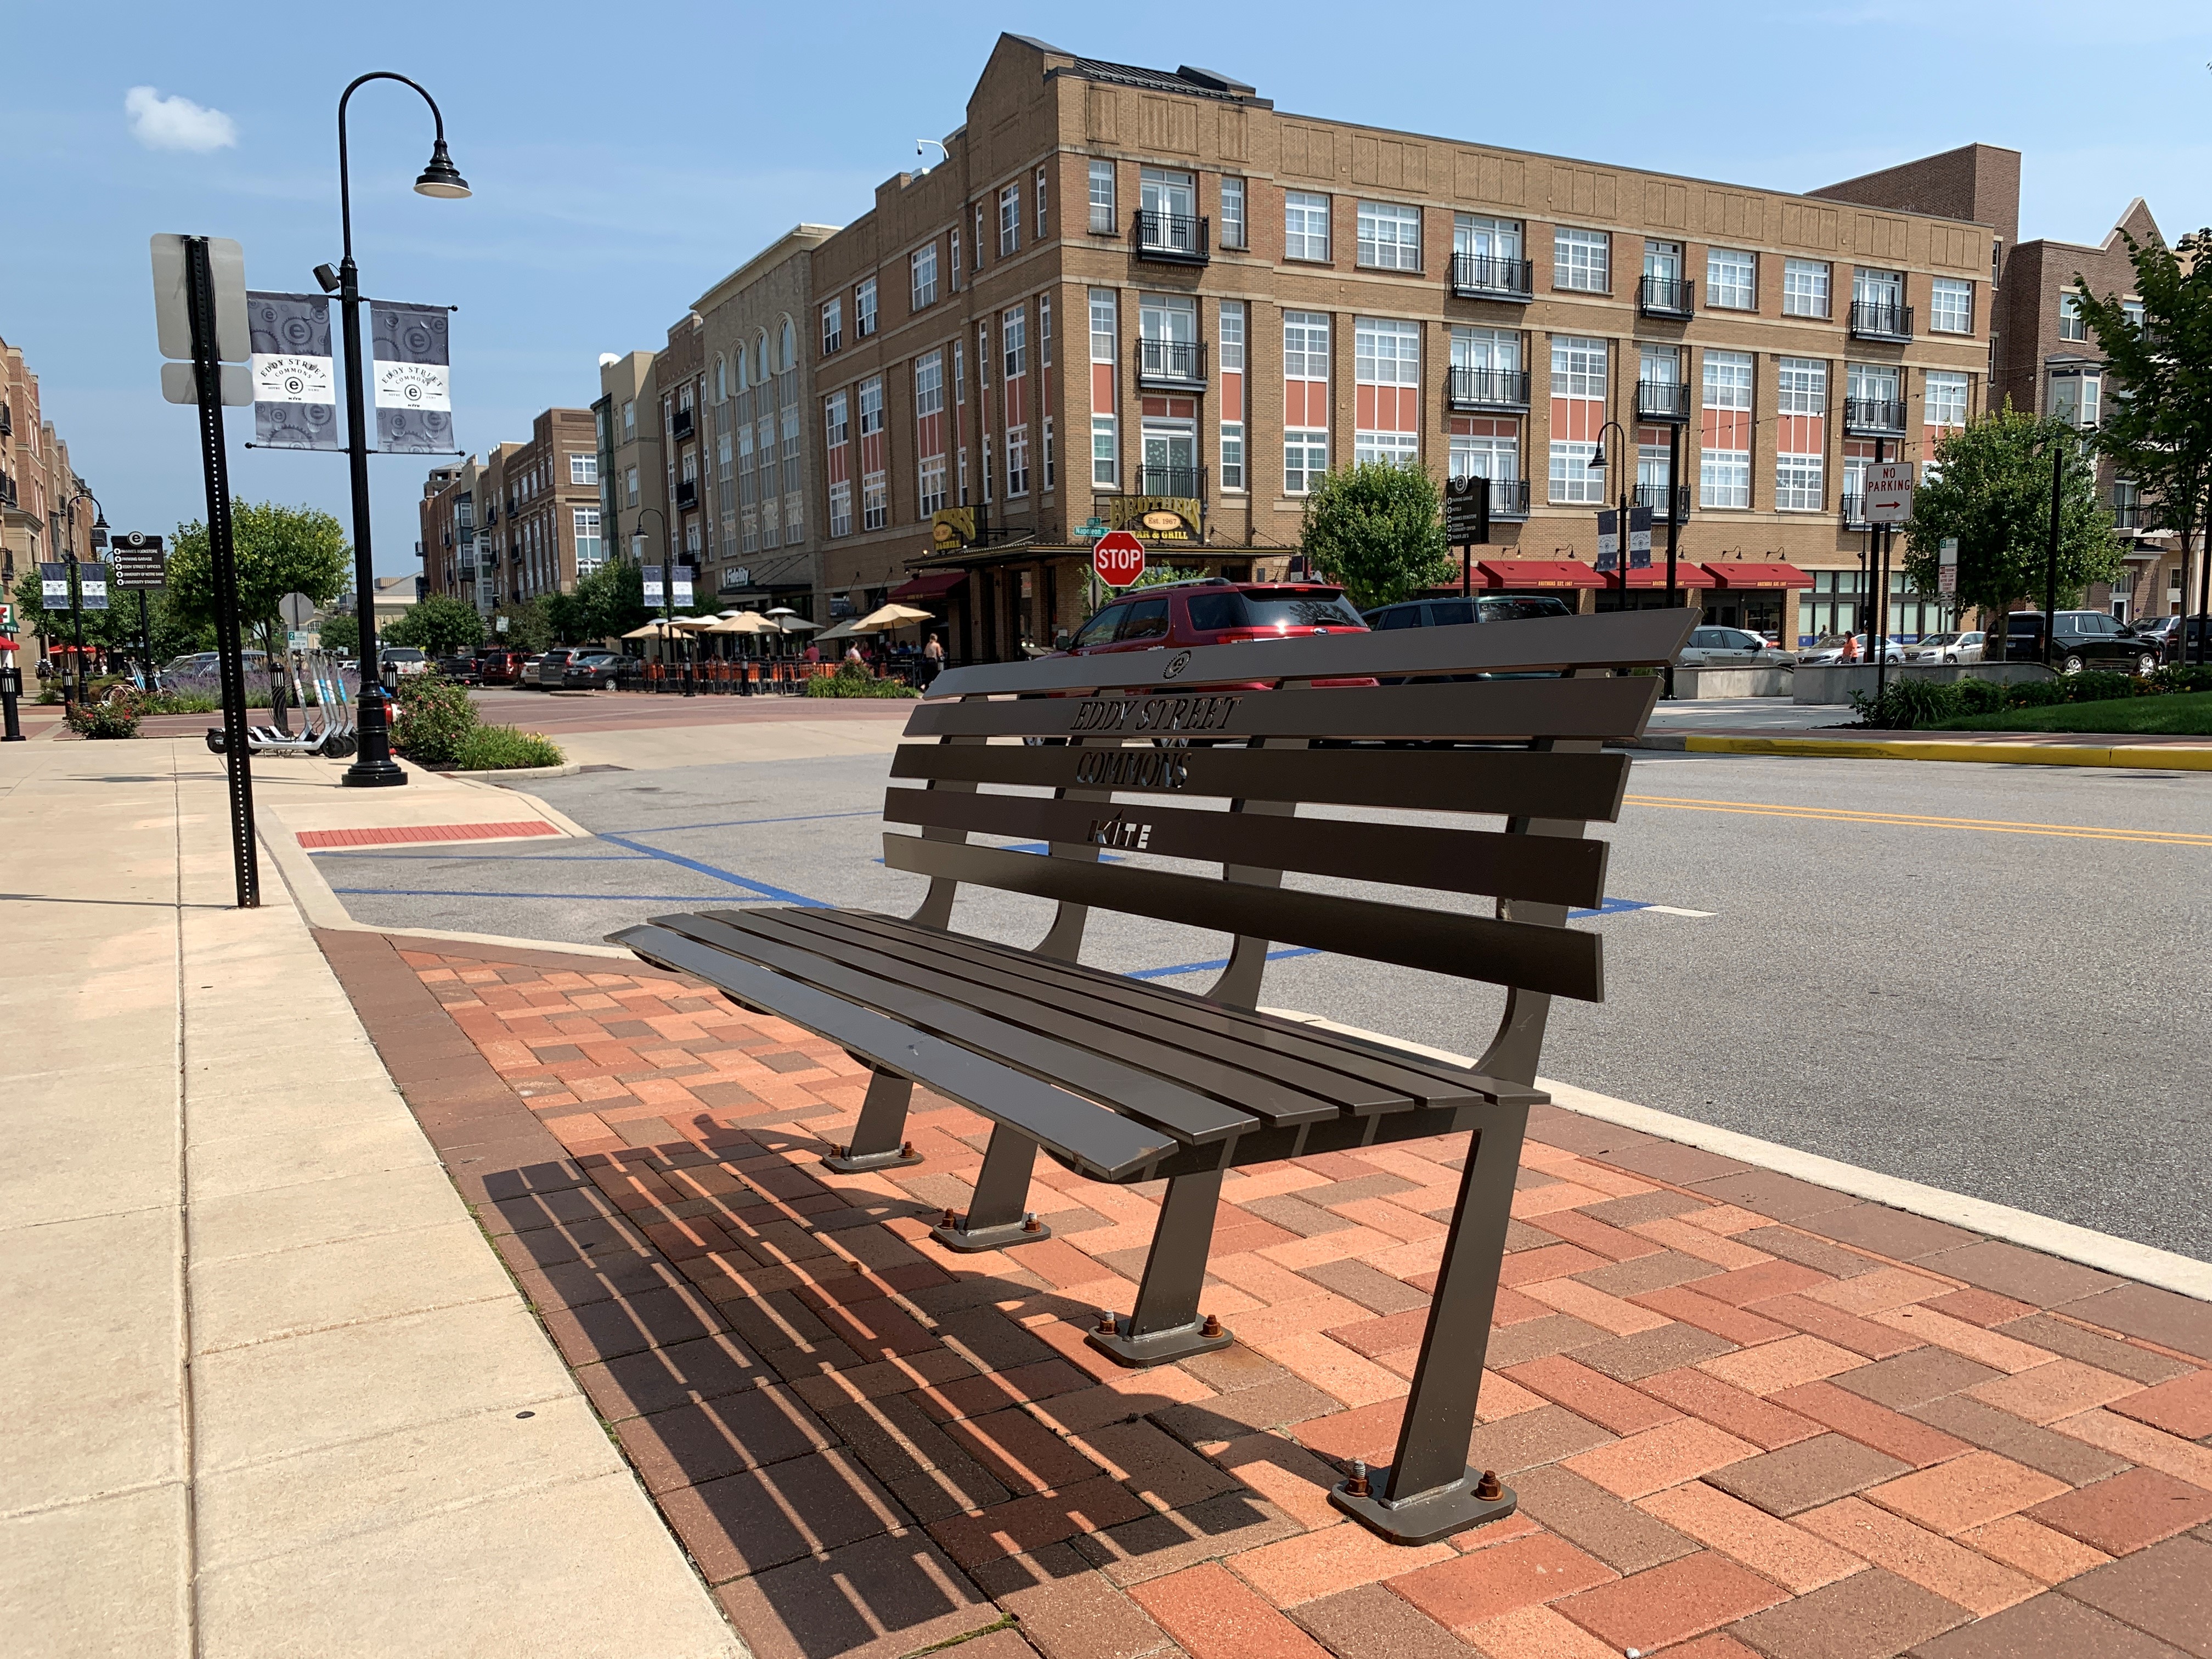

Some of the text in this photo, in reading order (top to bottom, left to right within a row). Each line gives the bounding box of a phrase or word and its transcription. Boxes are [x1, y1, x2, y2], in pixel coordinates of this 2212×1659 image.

[261, 358, 326, 379] EDDY STREET
[275, 368, 312, 379] COMMONS
[381, 366, 443, 387] EDDY STREET
[395, 375, 430, 386] COMMONS
[1883, 467, 1895, 479] NO
[1868, 479, 1910, 492] PARKING
[1109, 495, 1201, 534] BROTHERS
[1131, 531, 1150, 539] BAR
[1161, 531, 1188, 540] GRILL
[1098, 549, 1141, 569] STOP
[727, 566, 749, 584] Fidelity
[1070, 696, 1244, 731] EDDY STREET
[1076, 752, 1192, 788] COMMONS
[1087, 808, 1152, 849] KITE
